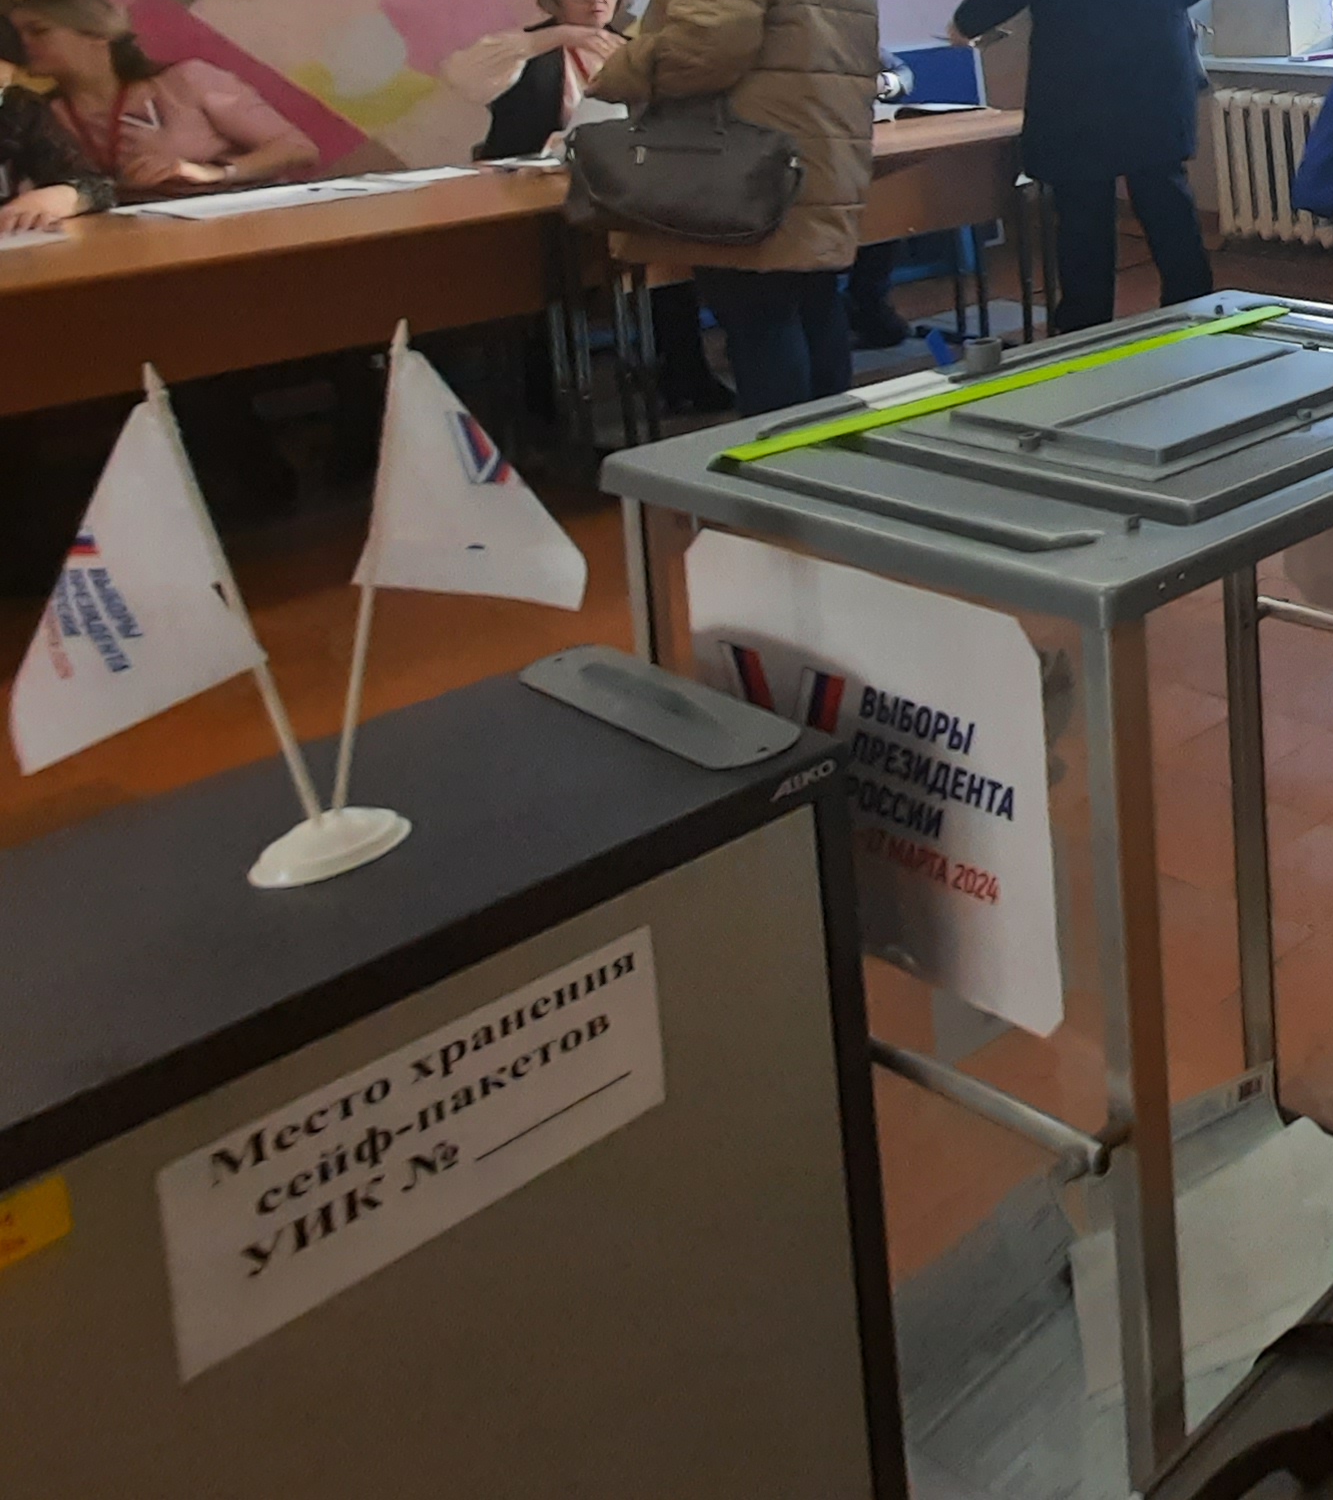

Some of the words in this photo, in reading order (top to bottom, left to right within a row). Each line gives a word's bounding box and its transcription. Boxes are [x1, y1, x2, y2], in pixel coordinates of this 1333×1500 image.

[851, 731, 1015, 821] ПРЕЗИДЕНТА
[859, 686, 975, 755] ВЫБОРЫ
[951, 863, 1000, 905] 2024
[209, 1076, 393, 1188] Место
[410, 951, 636, 1085] хранения
[255, 1013, 612, 1217] сейф-пакетов
[240, 1174, 386, 1278] УИК
[401, 1138, 461, 1192] №
